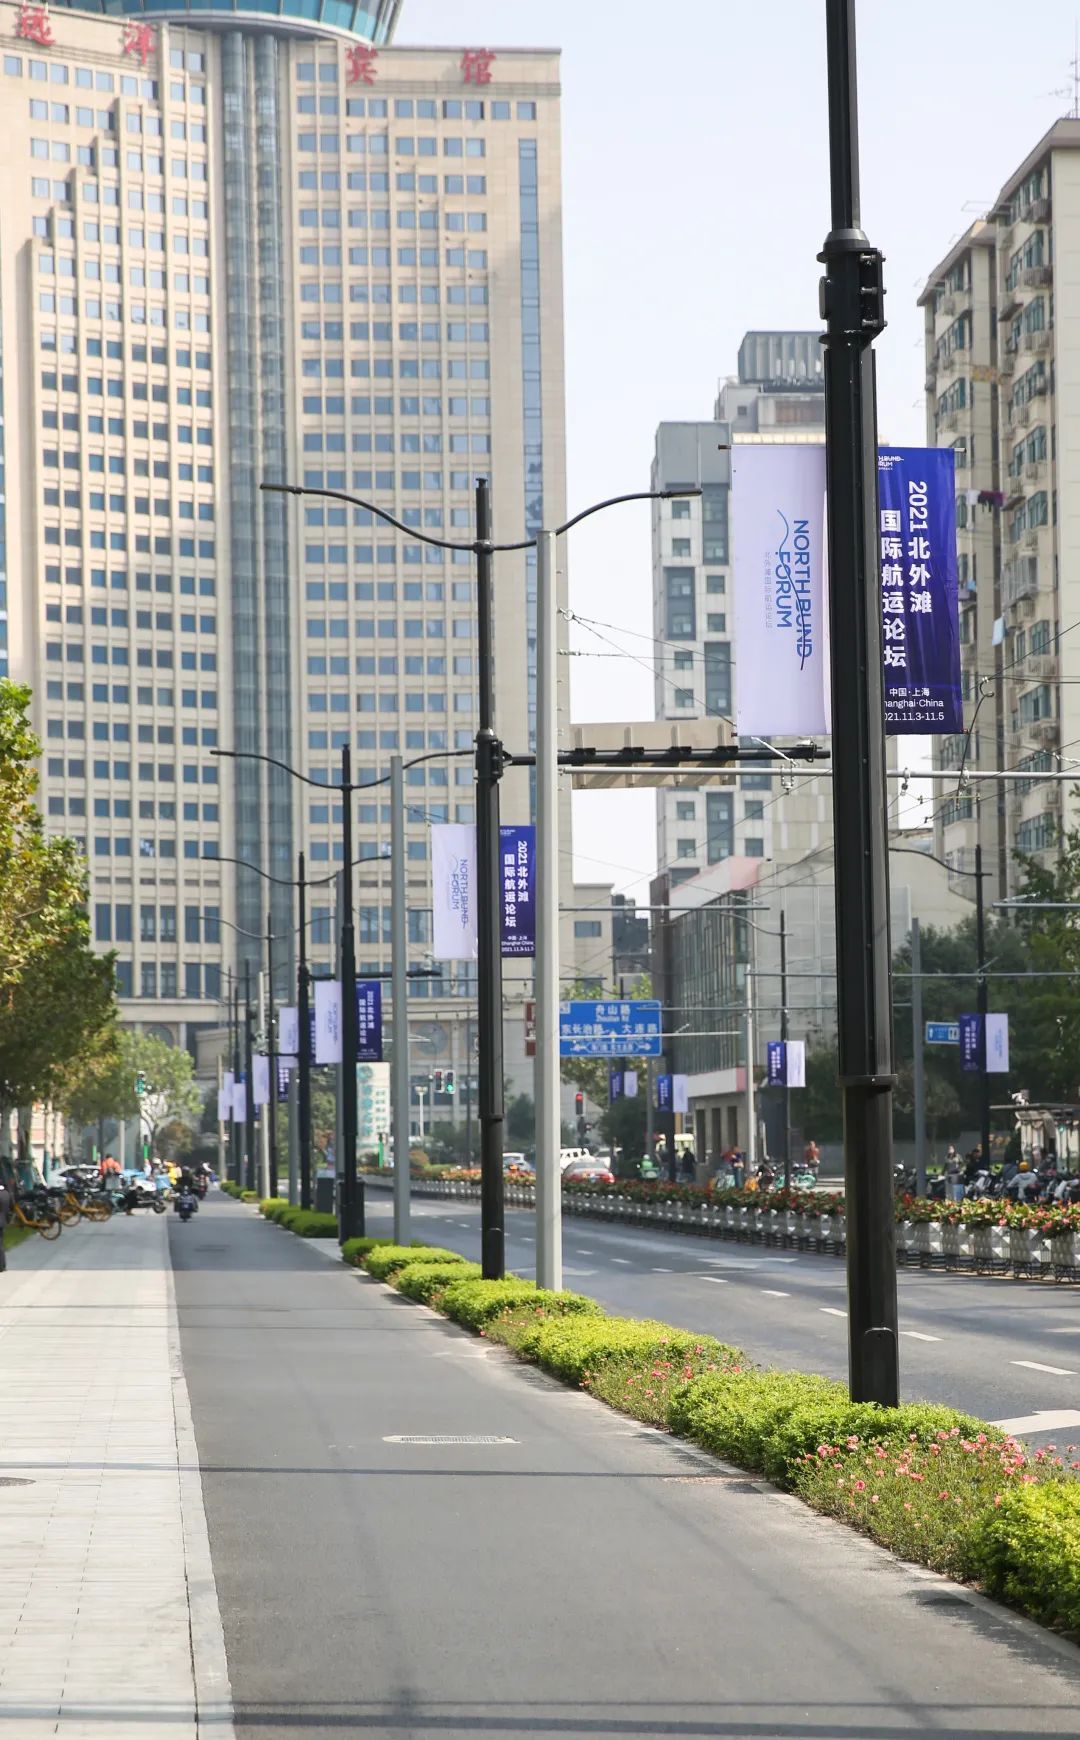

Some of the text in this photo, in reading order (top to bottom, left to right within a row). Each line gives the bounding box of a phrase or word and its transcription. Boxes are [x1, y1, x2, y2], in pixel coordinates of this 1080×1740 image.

[775, 551, 792, 628] FORUM
[794, 519, 813, 658] NORTH BUND
[881, 510, 906, 667] 国际航运论坛
[908, 481, 932, 614] 2021北外滩
[451, 873, 460, 909] FORUM
[460, 859, 468, 894] NORTH
